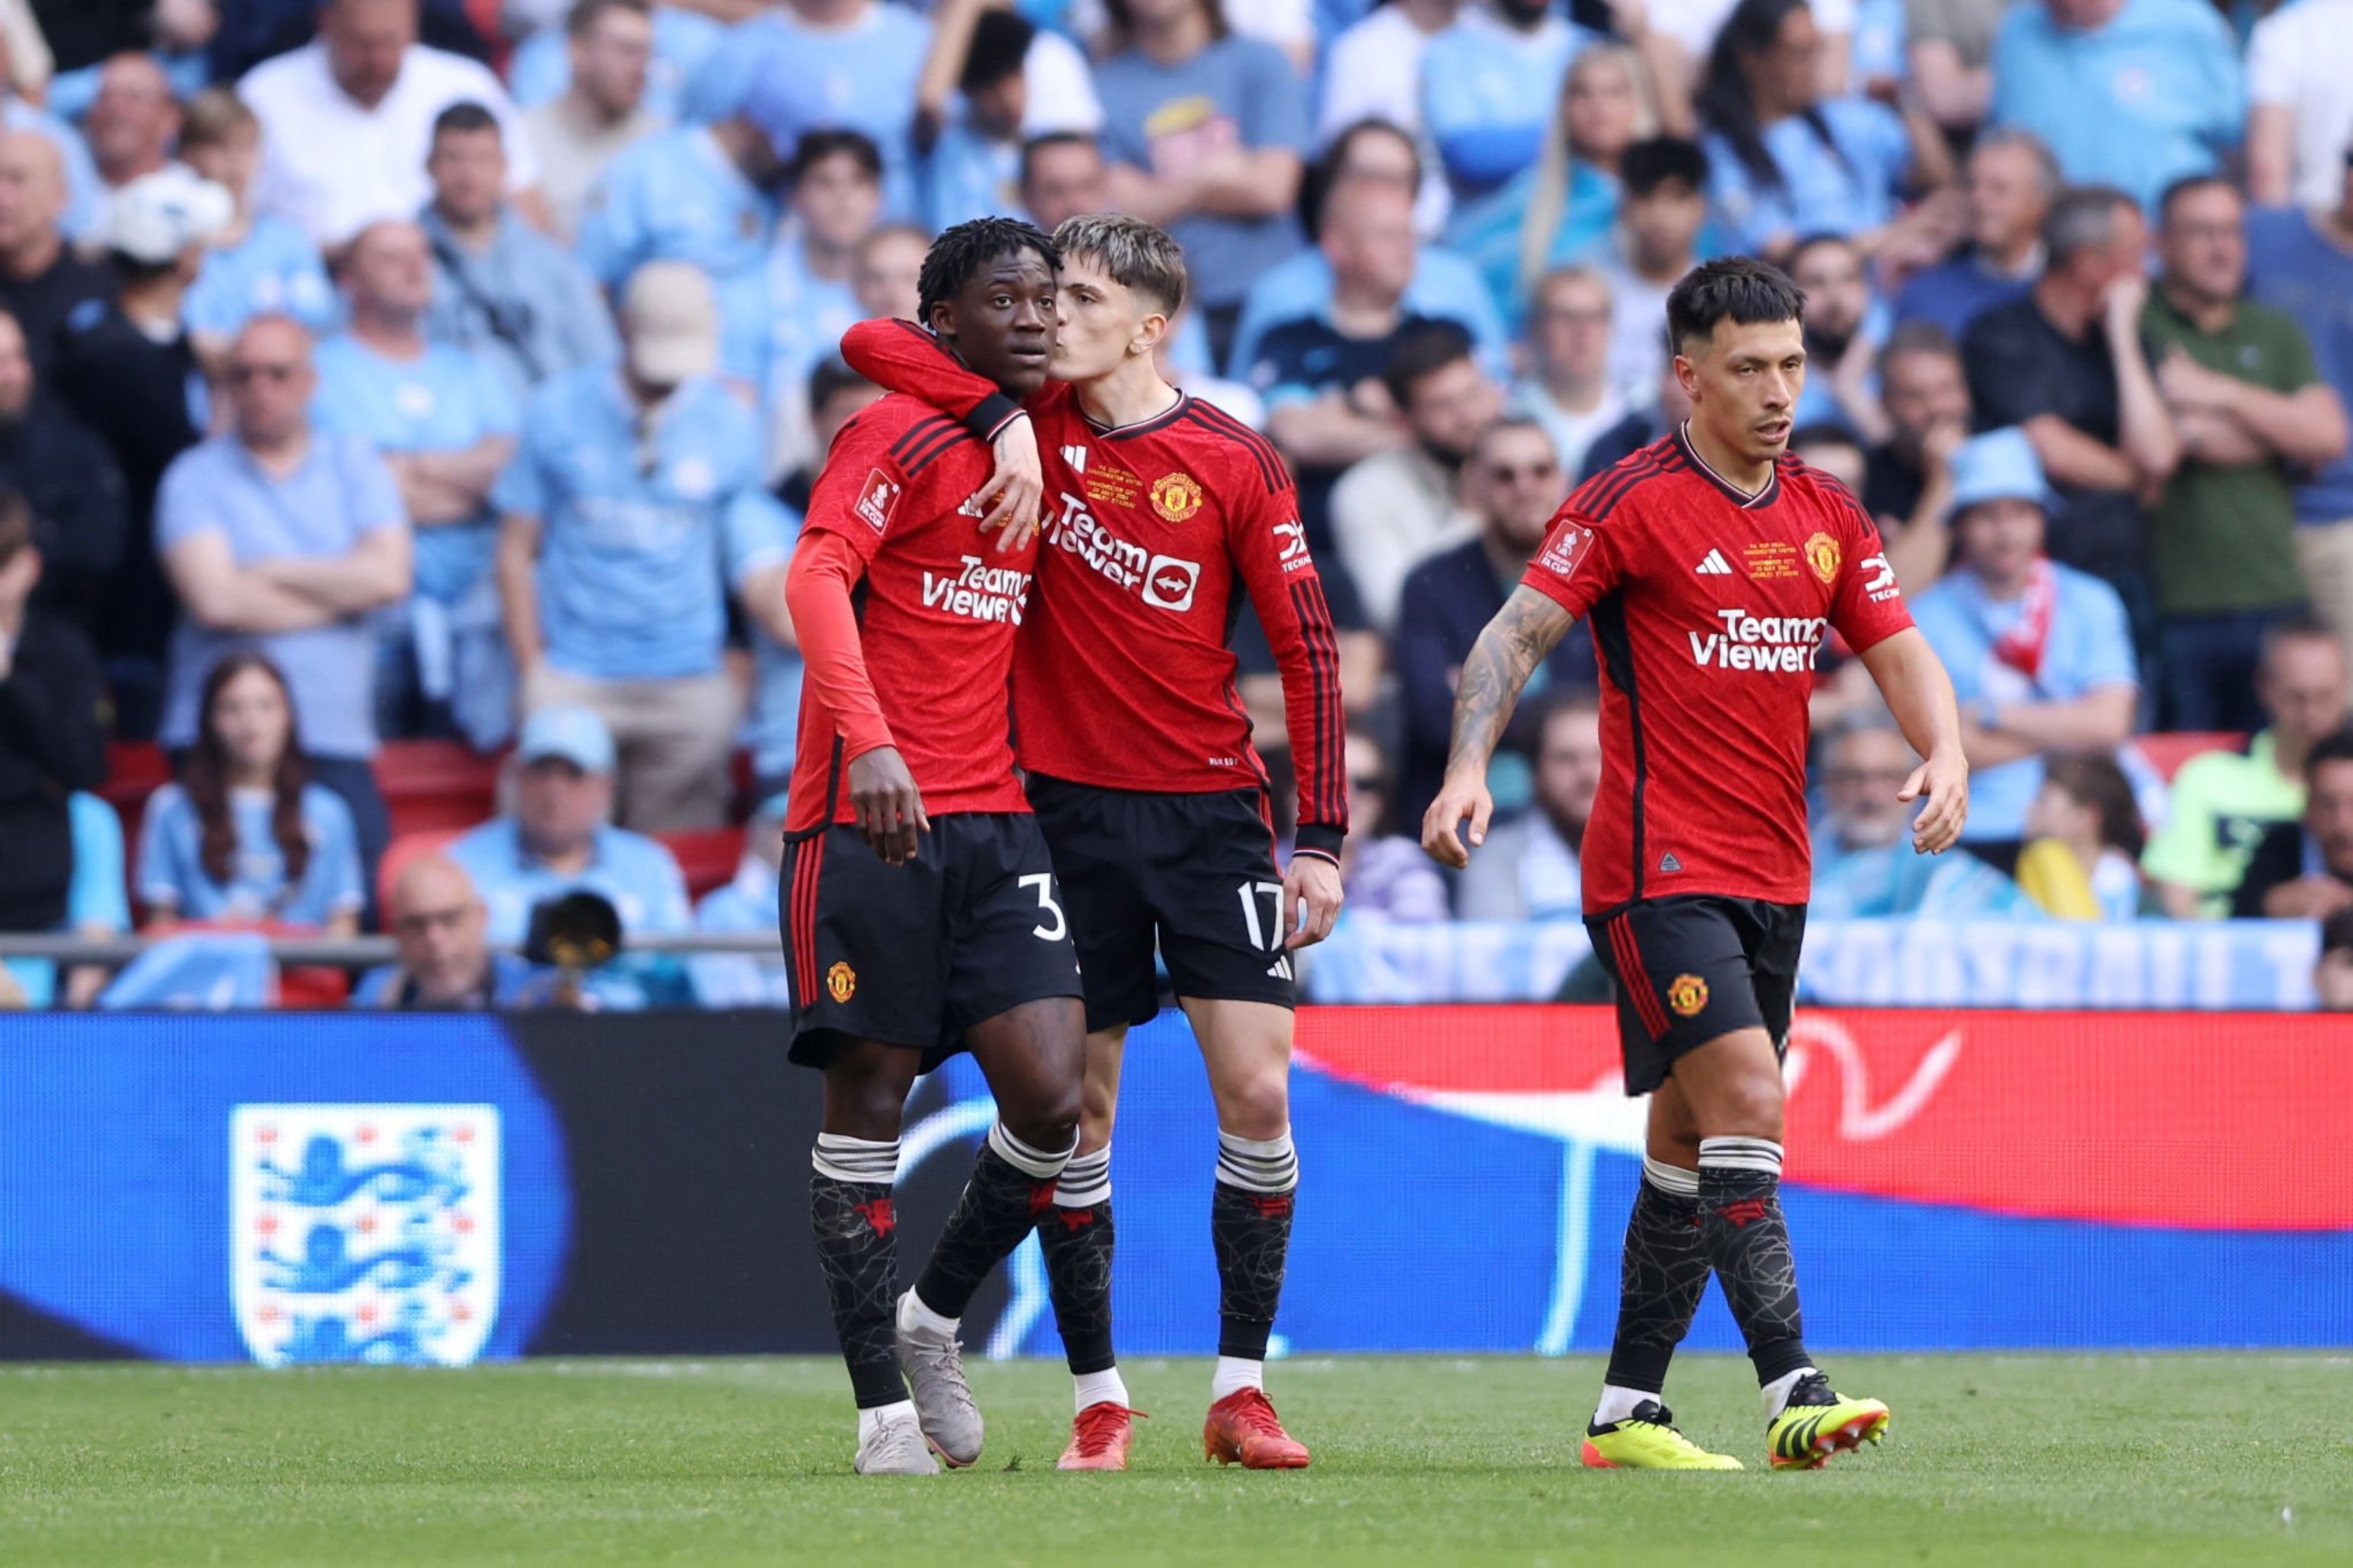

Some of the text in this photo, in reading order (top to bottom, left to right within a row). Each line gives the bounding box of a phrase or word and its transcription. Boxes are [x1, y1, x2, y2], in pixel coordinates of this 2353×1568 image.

[869, 512, 883, 527] CUP
[1060, 491, 1149, 574] Team
[1159, 508, 1189, 520] UNITED
[958, 554, 1022, 597] Team
[1540, 556, 1570, 575] FA CUP
[1717, 609, 1812, 643] Team
[1688, 630, 1808, 672] Viewer
[1237, 881, 1284, 952] 17
